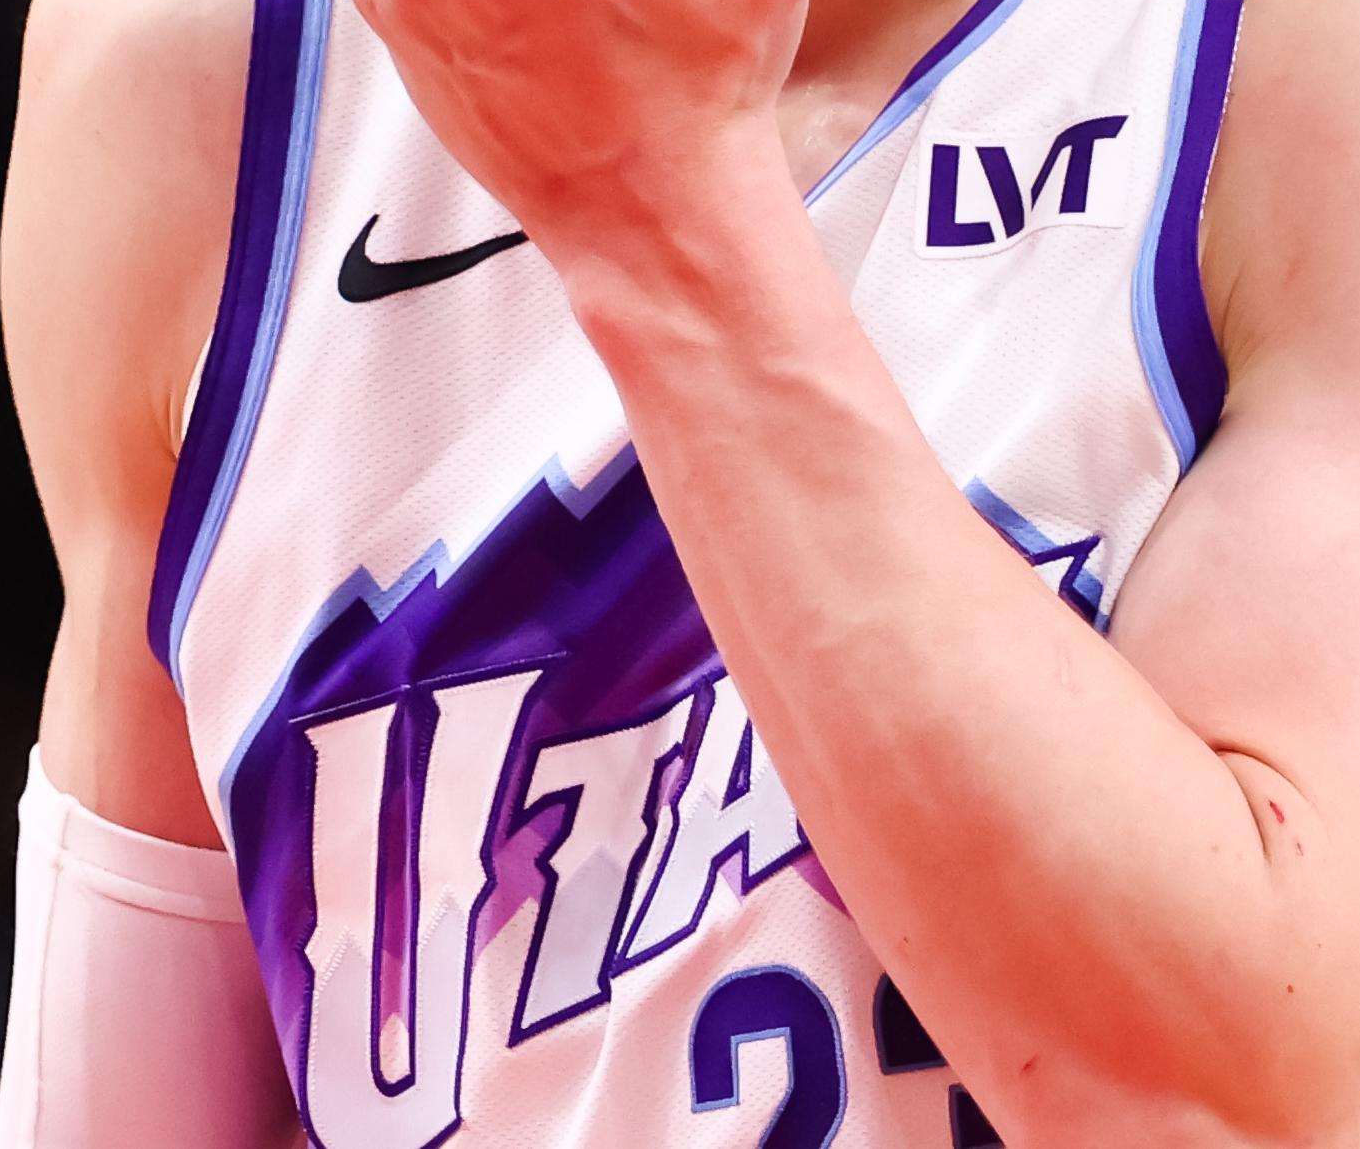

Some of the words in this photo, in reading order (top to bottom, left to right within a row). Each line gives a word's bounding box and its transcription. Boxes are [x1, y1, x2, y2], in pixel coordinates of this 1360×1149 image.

[926, 115, 1129, 247] LVT
[291, 651, 814, 1149] UTA
[689, 963, 1005, 1149] 2
